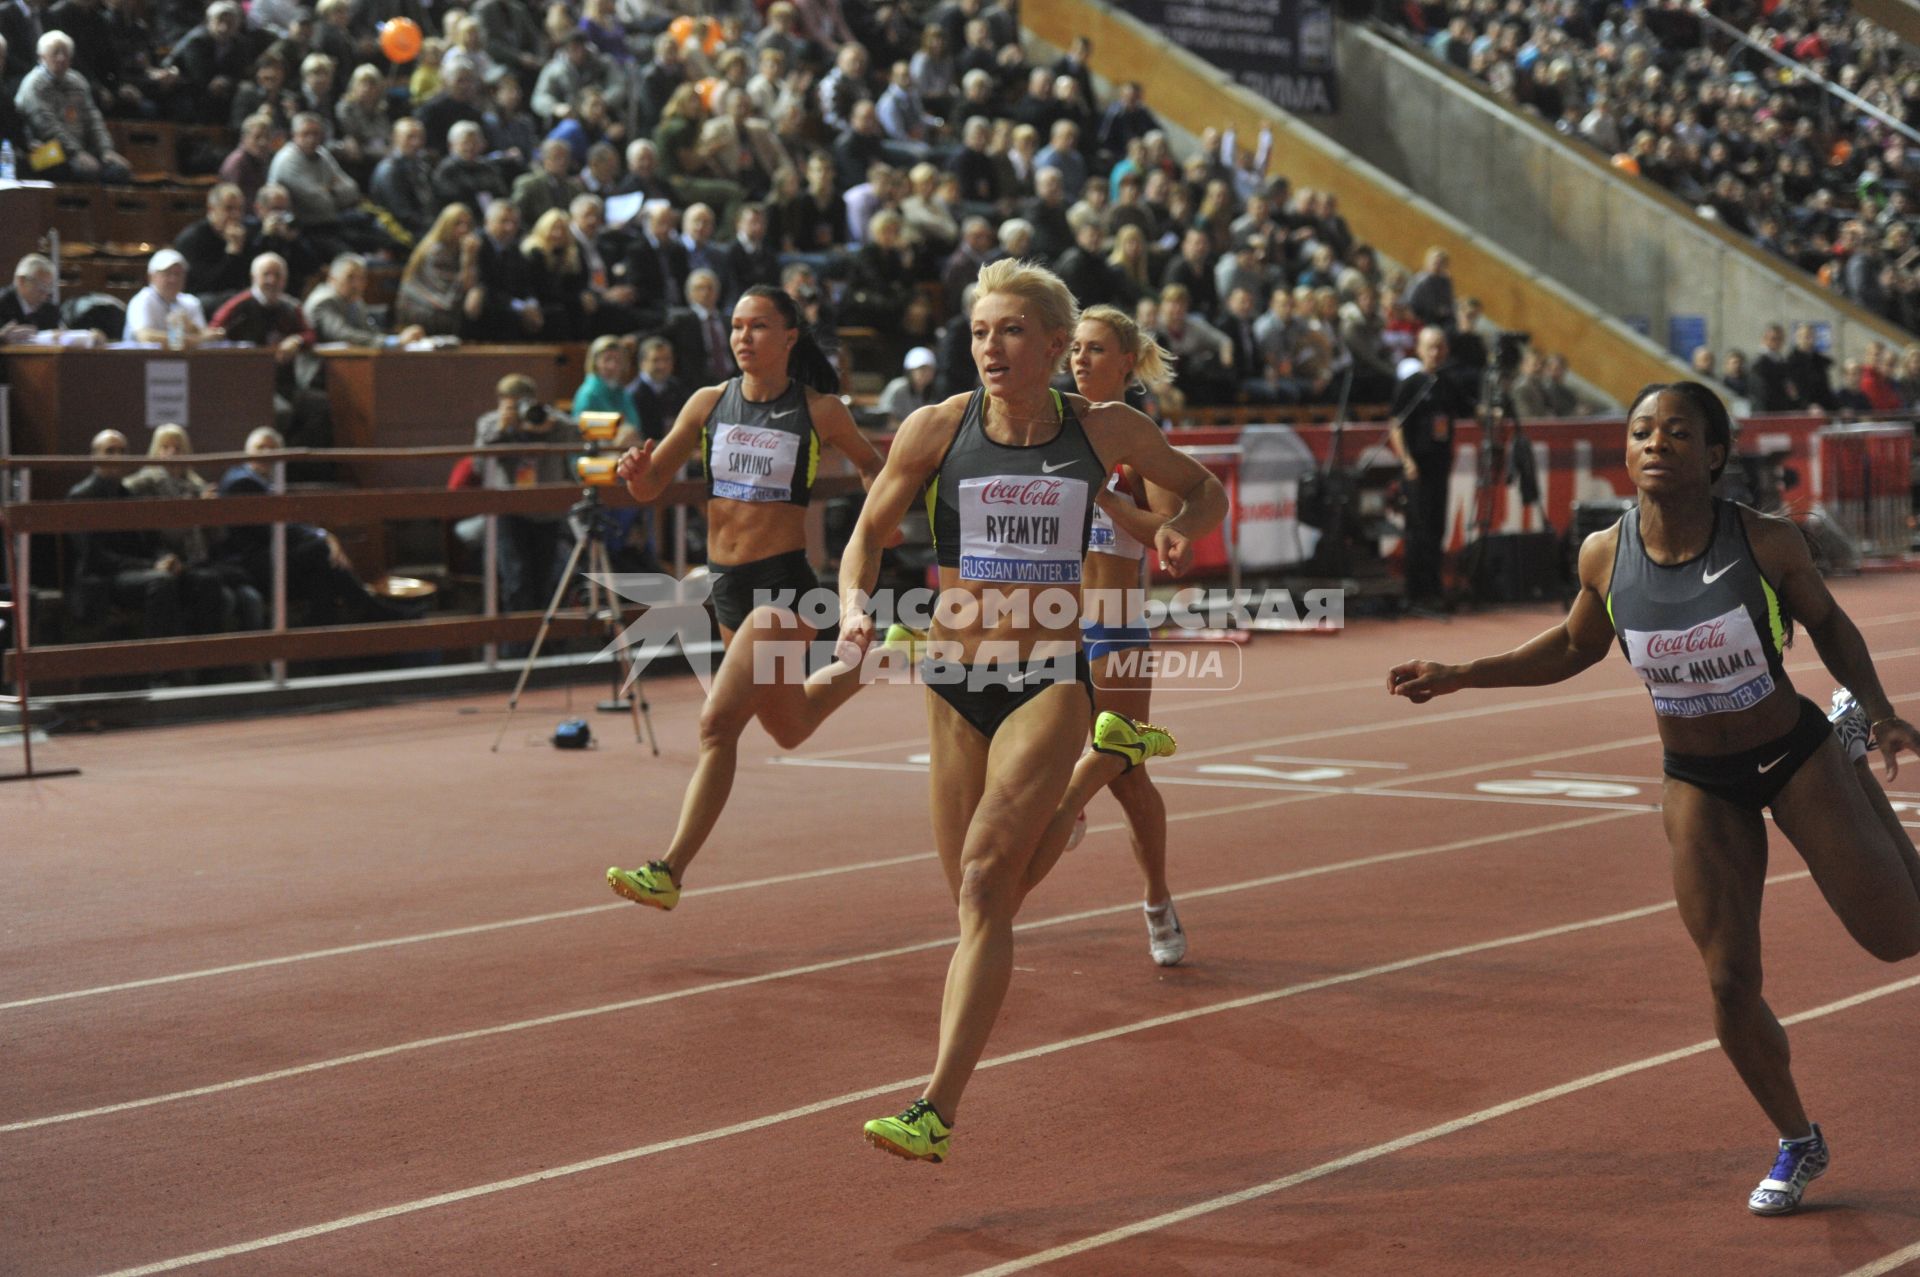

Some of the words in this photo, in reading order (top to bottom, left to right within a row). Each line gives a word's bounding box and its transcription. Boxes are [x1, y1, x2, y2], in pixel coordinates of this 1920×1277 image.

[981, 479, 1064, 506] Coca-Cola
[986, 515, 1059, 545] RYEMYEN
[963, 560, 1012, 579] RUSSIAN
[1016, 562, 1063, 580] WINTER
[1647, 619, 1727, 659] Coca-Cola
[1689, 649, 1756, 682] MILAMA
[1657, 698, 1707, 715] RUSSIAN
[1707, 686, 1756, 710] WINTER
